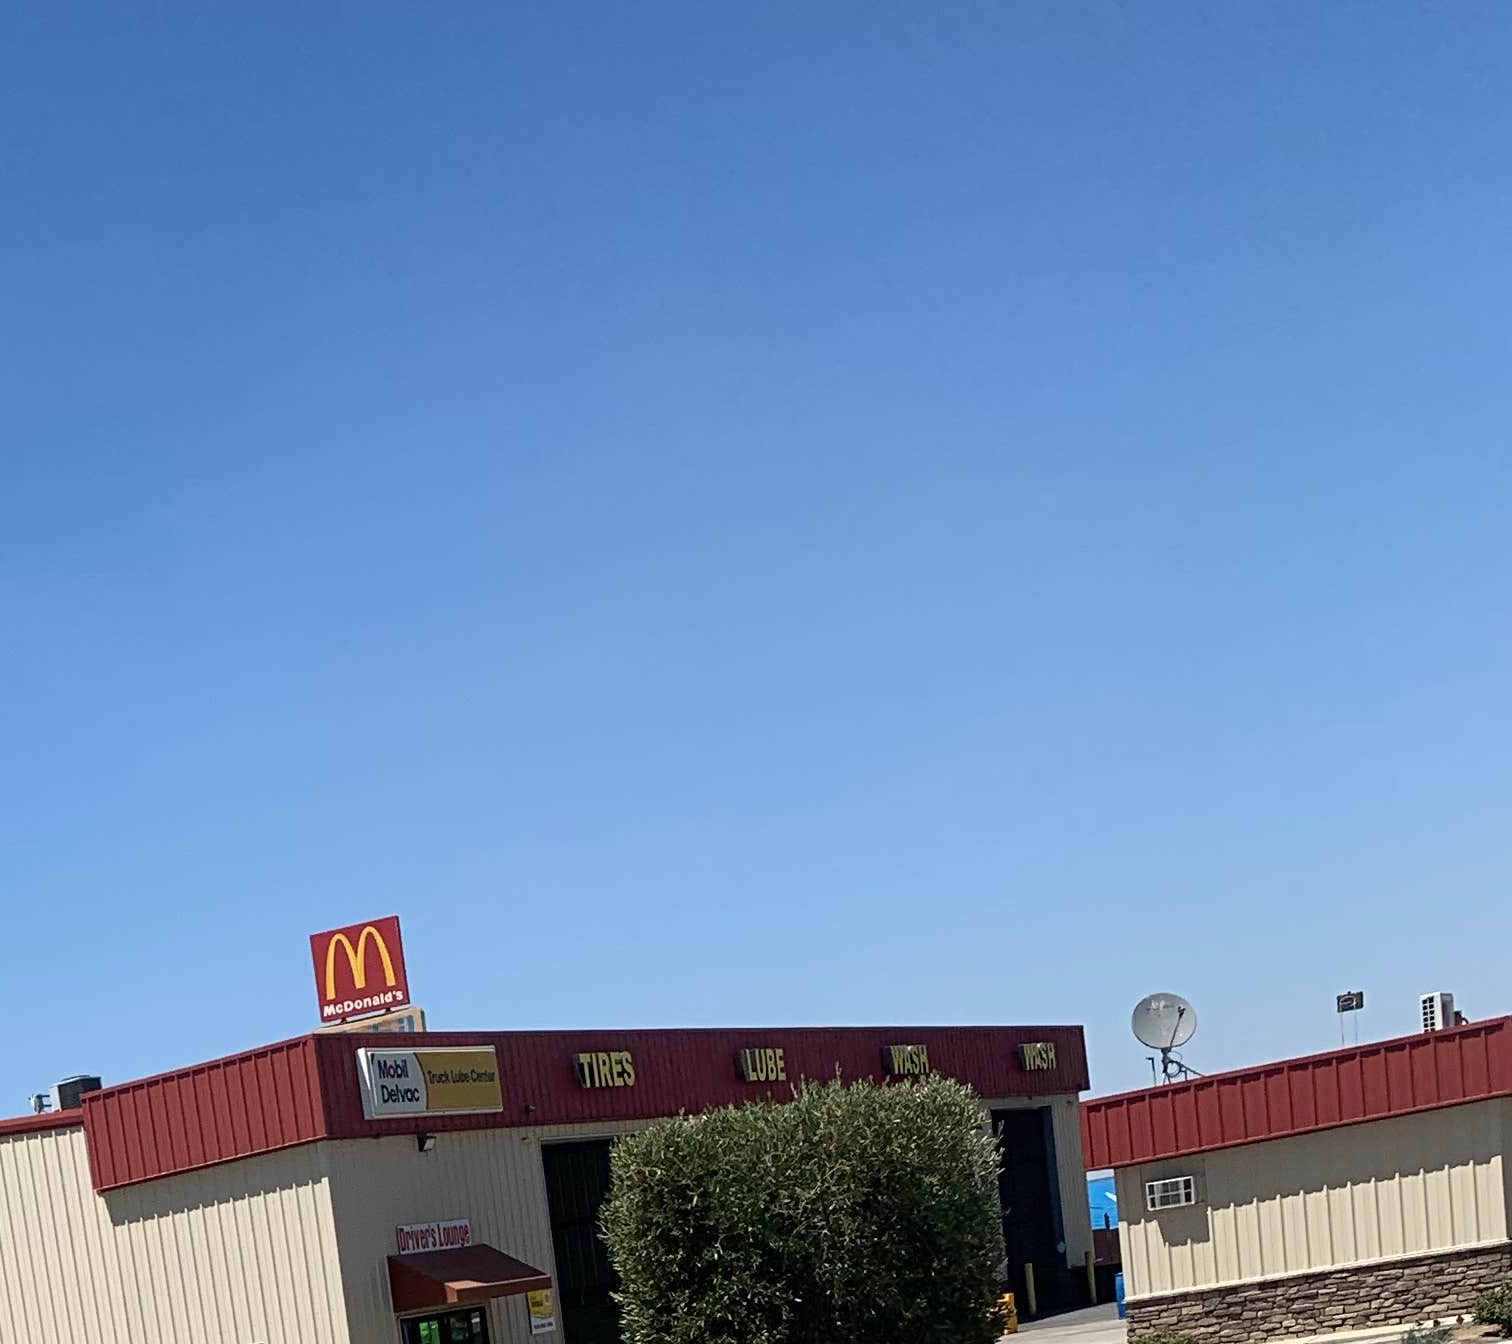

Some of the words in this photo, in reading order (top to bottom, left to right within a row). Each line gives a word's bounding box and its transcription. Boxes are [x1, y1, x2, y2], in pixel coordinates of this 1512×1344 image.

[322, 990, 404, 1017] McDonald's
[377, 1058, 409, 1079] Mobil
[577, 1051, 637, 1088] TIRES
[744, 1048, 787, 1081] LUBE
[889, 1044, 930, 1075] WASH
[1021, 1042, 1057, 1071] WASH
[427, 1070, 450, 1085] Truck
[450, 1069, 470, 1084] Lube
[470, 1069, 496, 1083] Center
[380, 1084, 420, 1103] Delvac
[398, 1225, 438, 1252] Driver's
[437, 1223, 471, 1247] Lounge
